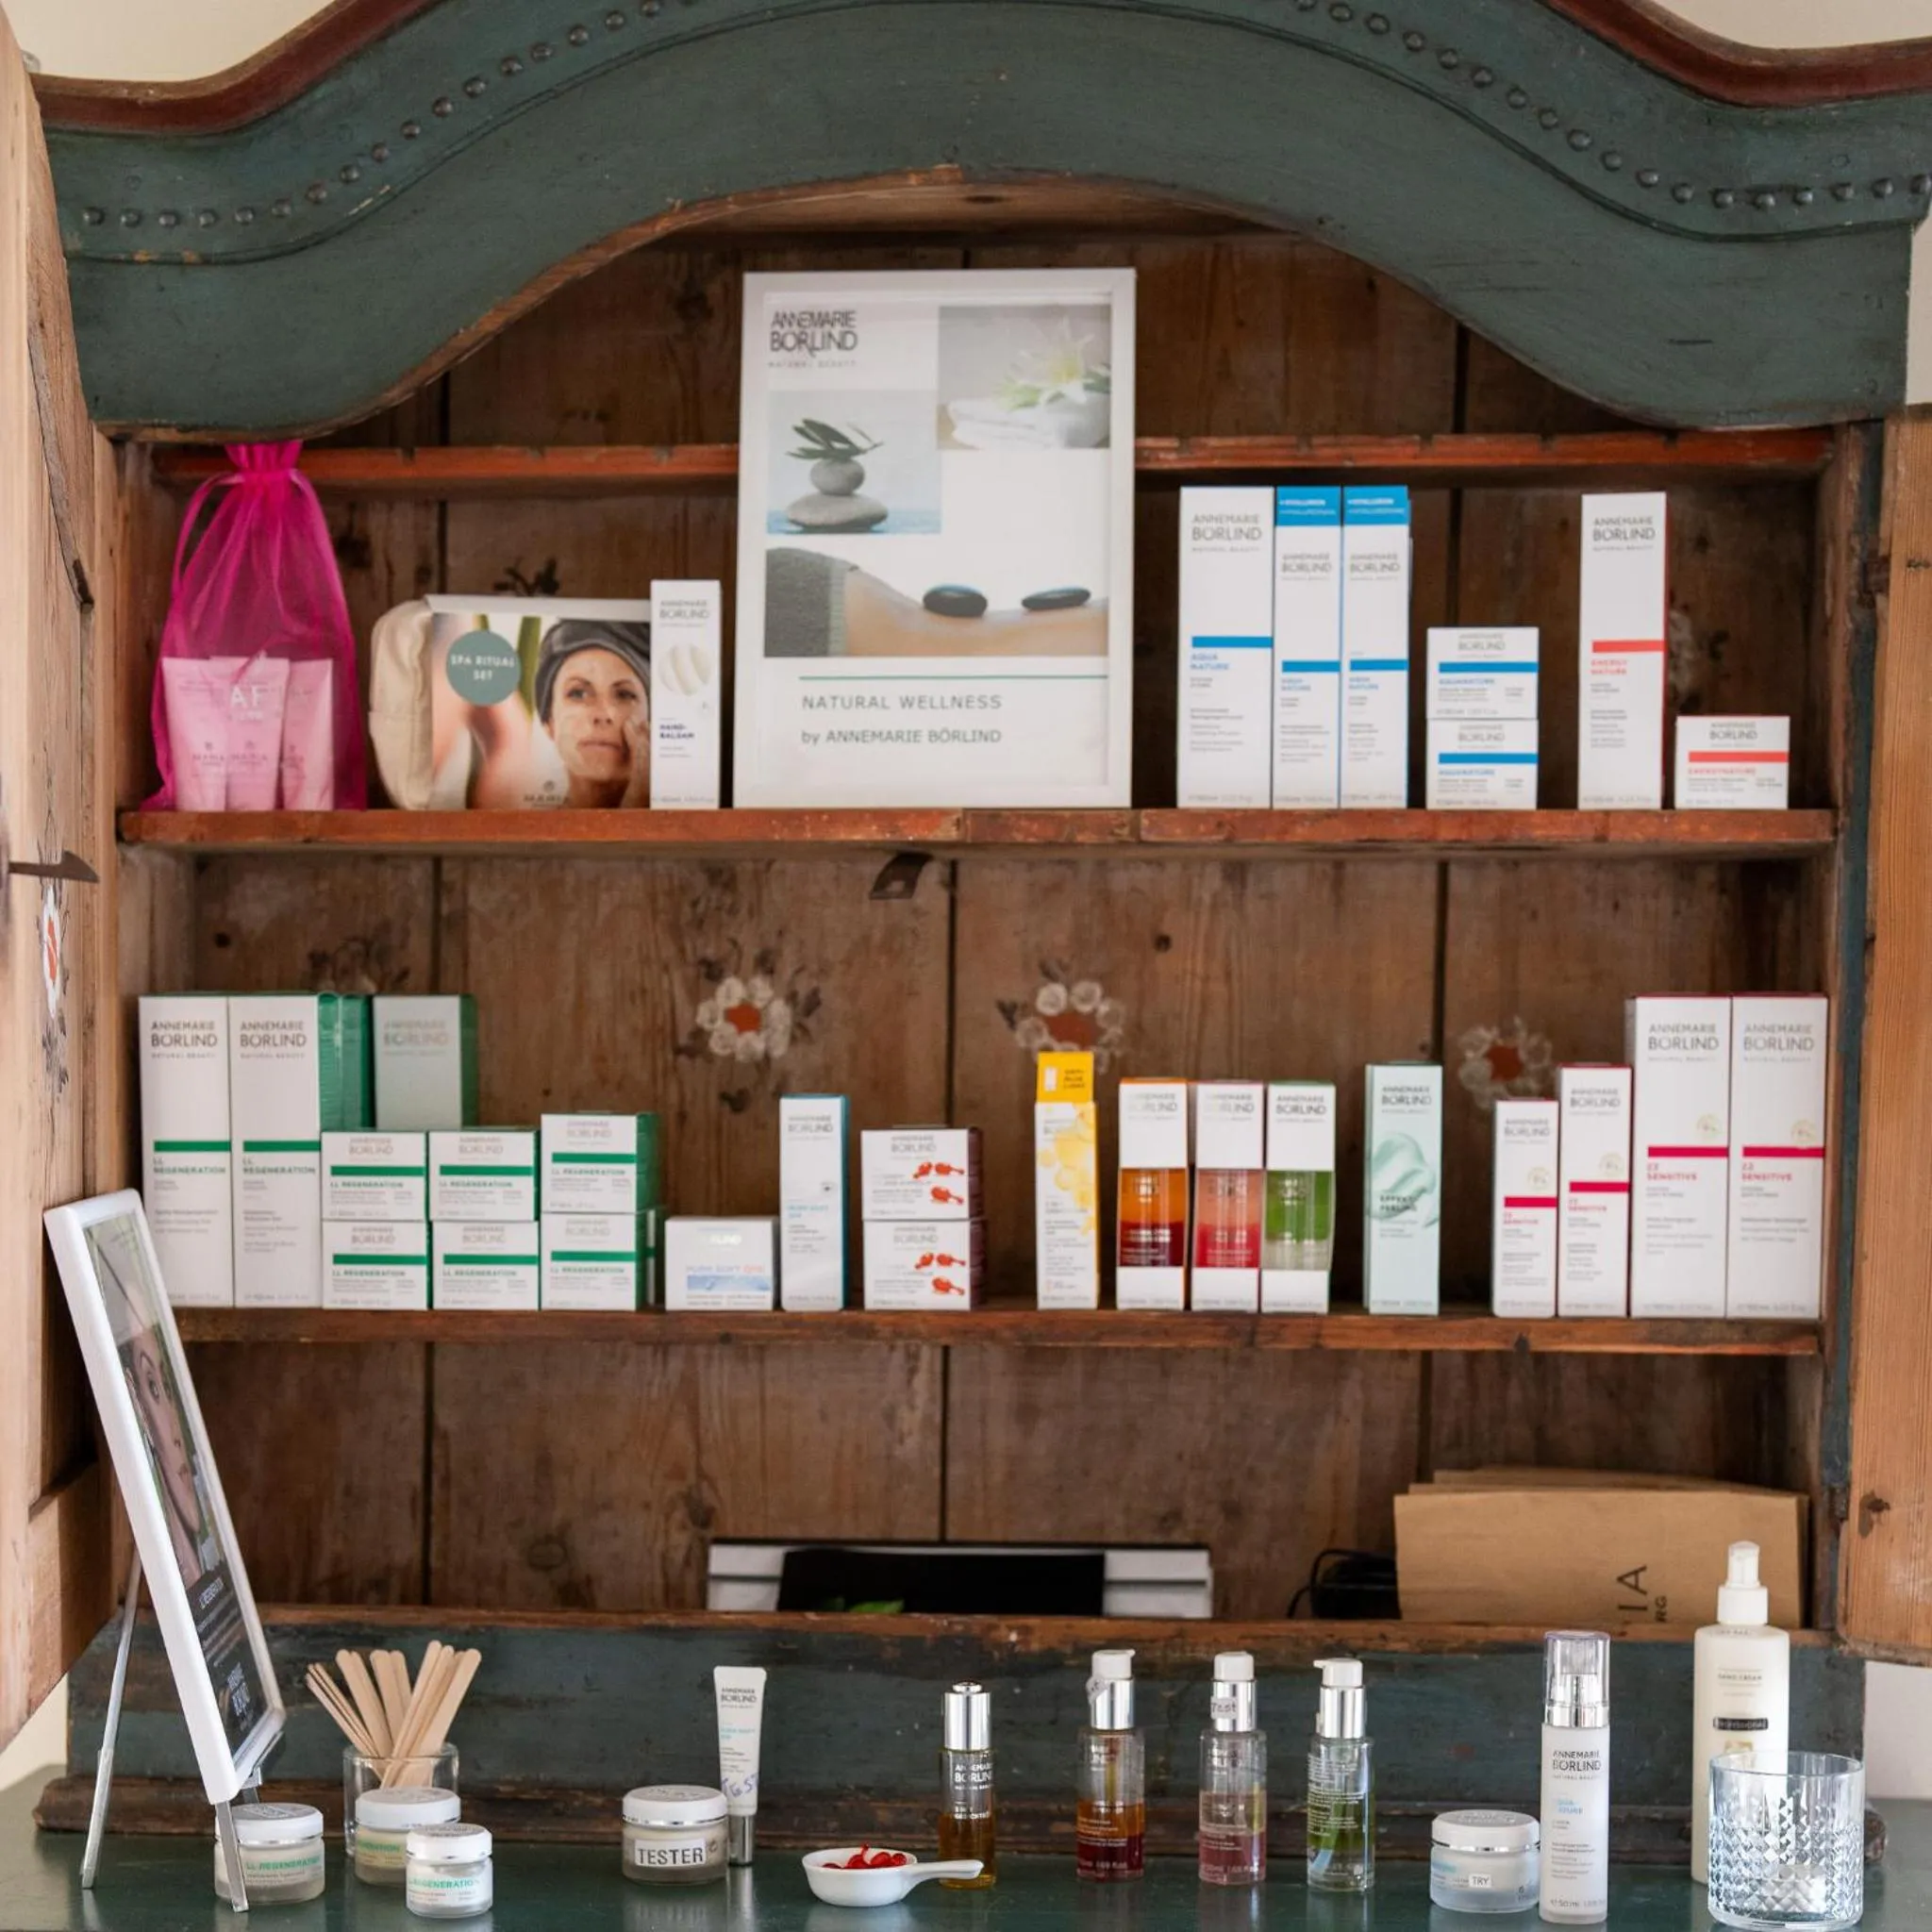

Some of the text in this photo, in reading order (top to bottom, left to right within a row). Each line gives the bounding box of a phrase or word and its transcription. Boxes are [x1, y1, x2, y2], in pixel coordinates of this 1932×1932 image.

[474, 670, 492, 680] SET
[802, 695, 1003, 709] NATURAL WELLNESS
[802, 727, 1002, 746] by ANNEMARIE BÖRLIND
[153, 1166, 225, 1174] REGENERATION
[243, 1166, 316, 1174] REGENERATION
[638, 1848, 704, 1865] TESTER
[1472, 1875, 1490, 1886] TRY
